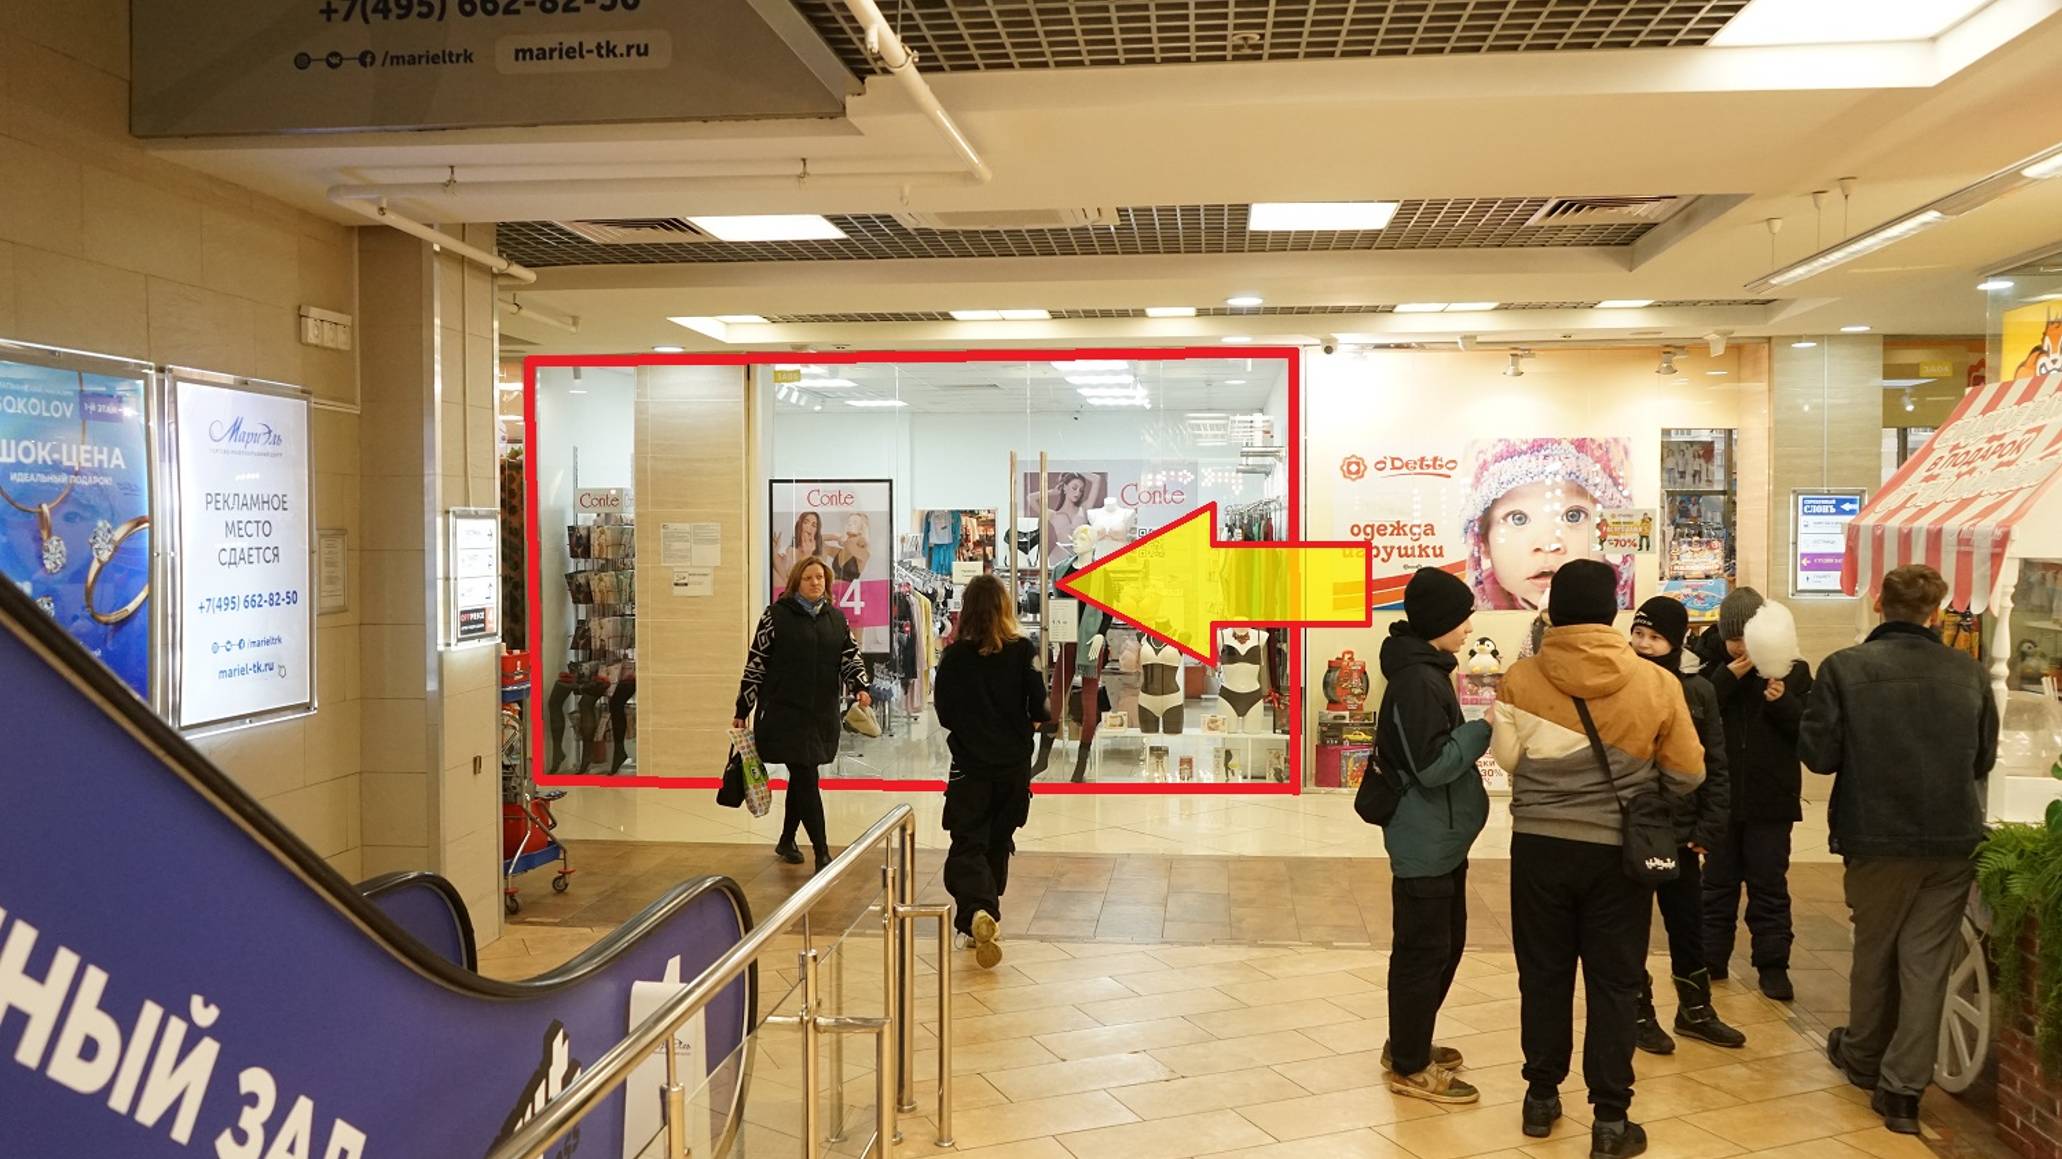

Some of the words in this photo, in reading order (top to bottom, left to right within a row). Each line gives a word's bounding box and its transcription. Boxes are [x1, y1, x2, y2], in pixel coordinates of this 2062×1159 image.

[319, 0, 447, 24] +7(495)
[381, 49, 474, 67] /marieltrk
[514, 40, 649, 61] mariel-tk.ru
[0, 395, 74, 418] OKOLOV
[0, 439, 126, 470] ШОК-ЦЕНА
[1939, 436, 2031, 469] ПОДАРОК
[10, 471, 67, 484] ИДЕАЛЬНЫЙ
[205, 492, 289, 511] РЕКЛАМНОЕ
[579, 492, 620, 509] Conte
[807, 488, 855, 508] Conte
[1120, 483, 1185, 506] Conte
[225, 520, 273, 538] МЕСТО
[1350, 520, 1436, 541] одежда
[218, 546, 280, 567] СДАЕТСЯ
[198, 595, 241, 614] +7(495)
[243, 590, 298, 609] 662-82-50
[839, 578, 865, 615] 4
[247, 634, 283, 649] /marieltrk
[218, 660, 275, 679] mariel-tk.ru
[0, 906, 221, 1146] НЫЙ
